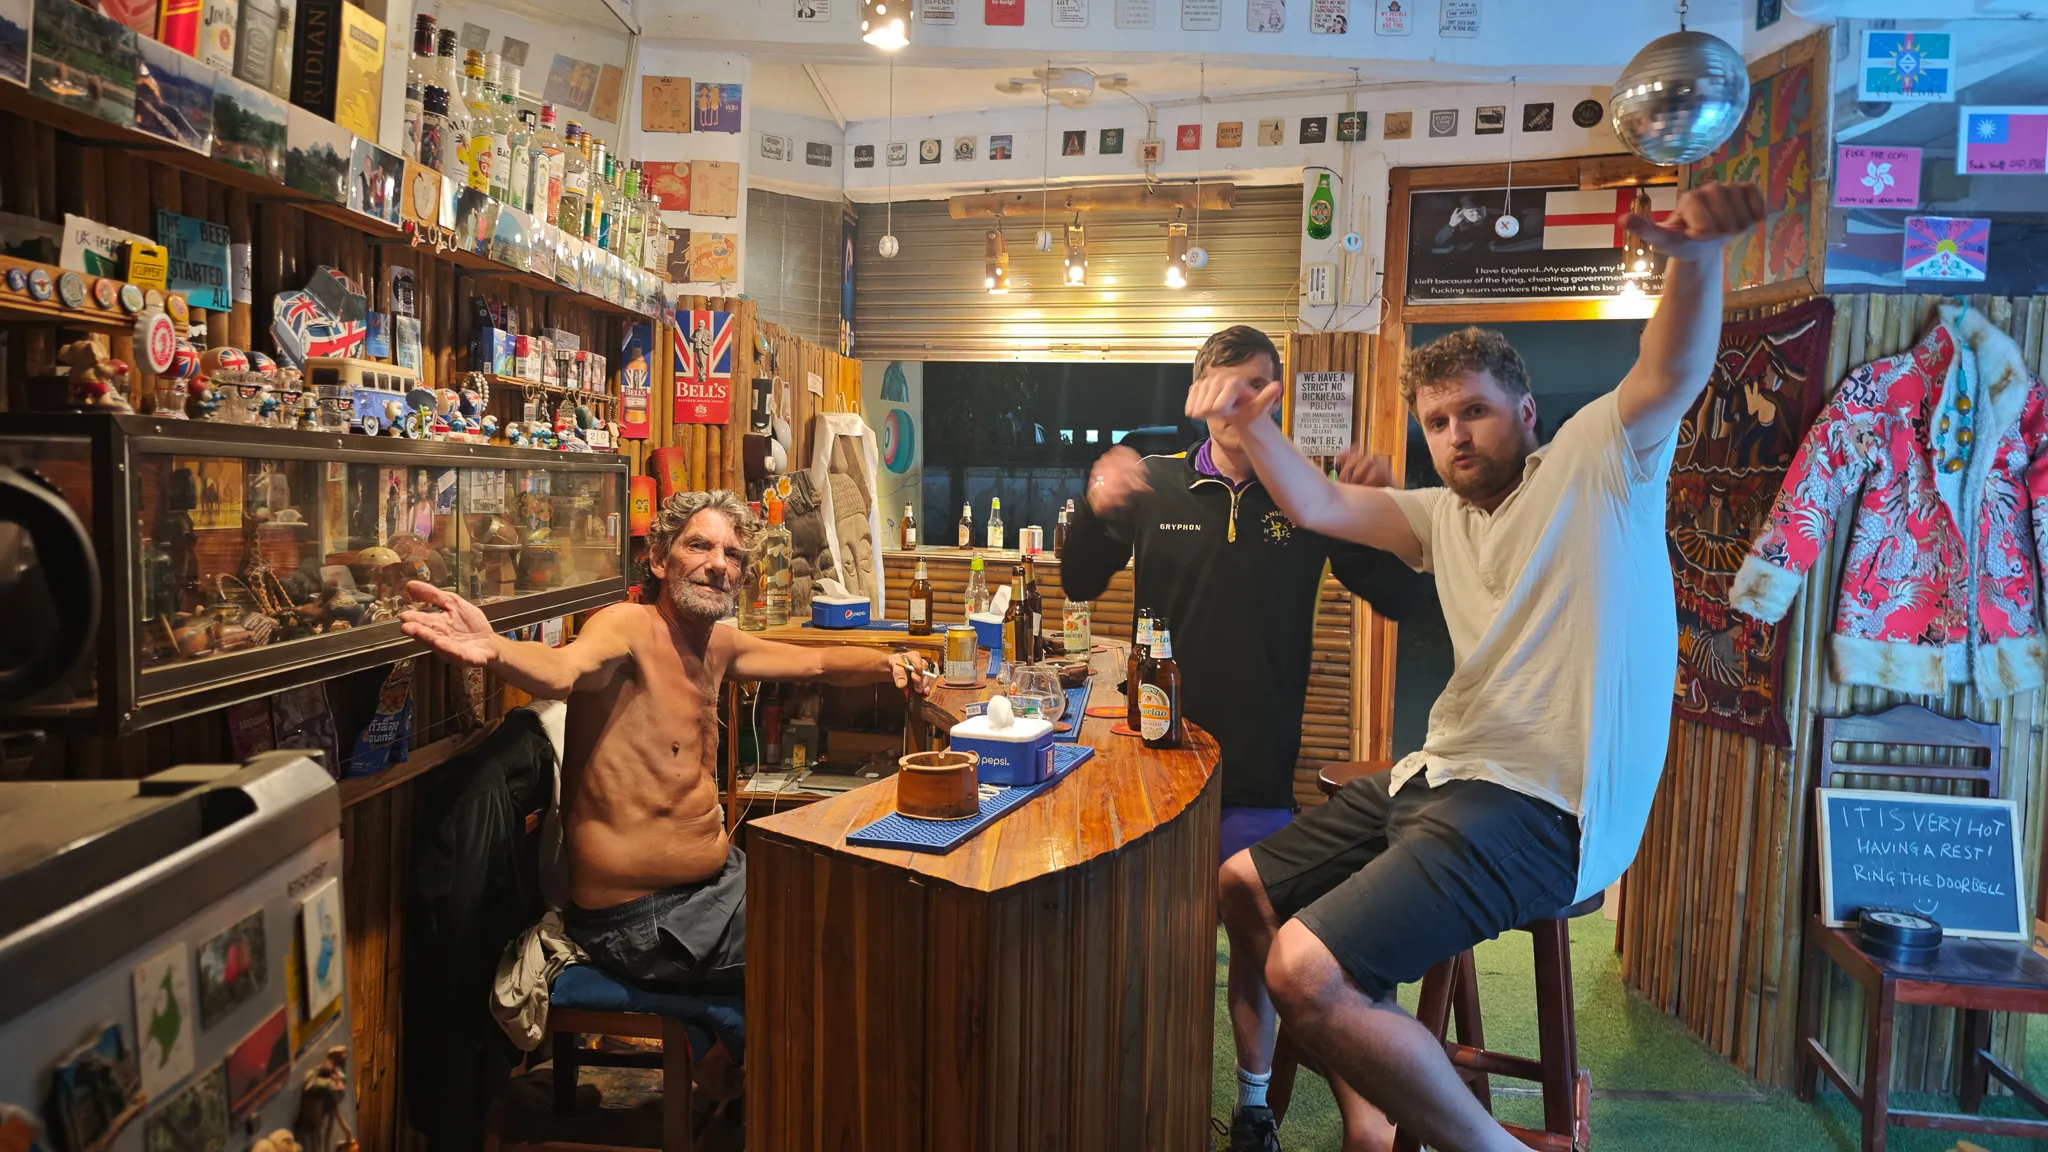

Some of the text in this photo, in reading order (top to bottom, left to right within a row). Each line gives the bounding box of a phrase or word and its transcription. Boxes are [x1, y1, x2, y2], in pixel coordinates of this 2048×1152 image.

[159, 212, 181, 233] THE
[160, 233, 188, 260] THAT
[134, 265, 162, 279] CLIPPER
[170, 259, 224, 288] STARTED
[1560, 265, 1597, 274] country,
[1600, 266, 1616, 274] my
[1502, 277, 1526, 285] lying,
[1528, 275, 1569, 284] cheating
[1431, 287, 1464, 295] Fucking
[213, 288, 232, 310] ALL
[1304, 373, 1346, 382] WE HAVE A
[675, 382, 727, 398] BELL'S
[1302, 383, 1342, 391] STRICT NO
[625, 388, 647, 397] BELL'S
[1302, 392, 1346, 401] DICKHEADS
[1310, 402, 1338, 410] POLICY
[1301, 437, 1344, 445] DON'T BE A
[1159, 523, 1201, 531] GRYPHON
[1879, 807, 1905, 832] IS
[1913, 811, 1962, 836] VERY
[1968, 819, 2006, 837] HOT
[1857, 838, 1919, 857] HAVING
[1923, 846, 1936, 858] A
[1853, 864, 2005, 896] RING THE DOORBELL
